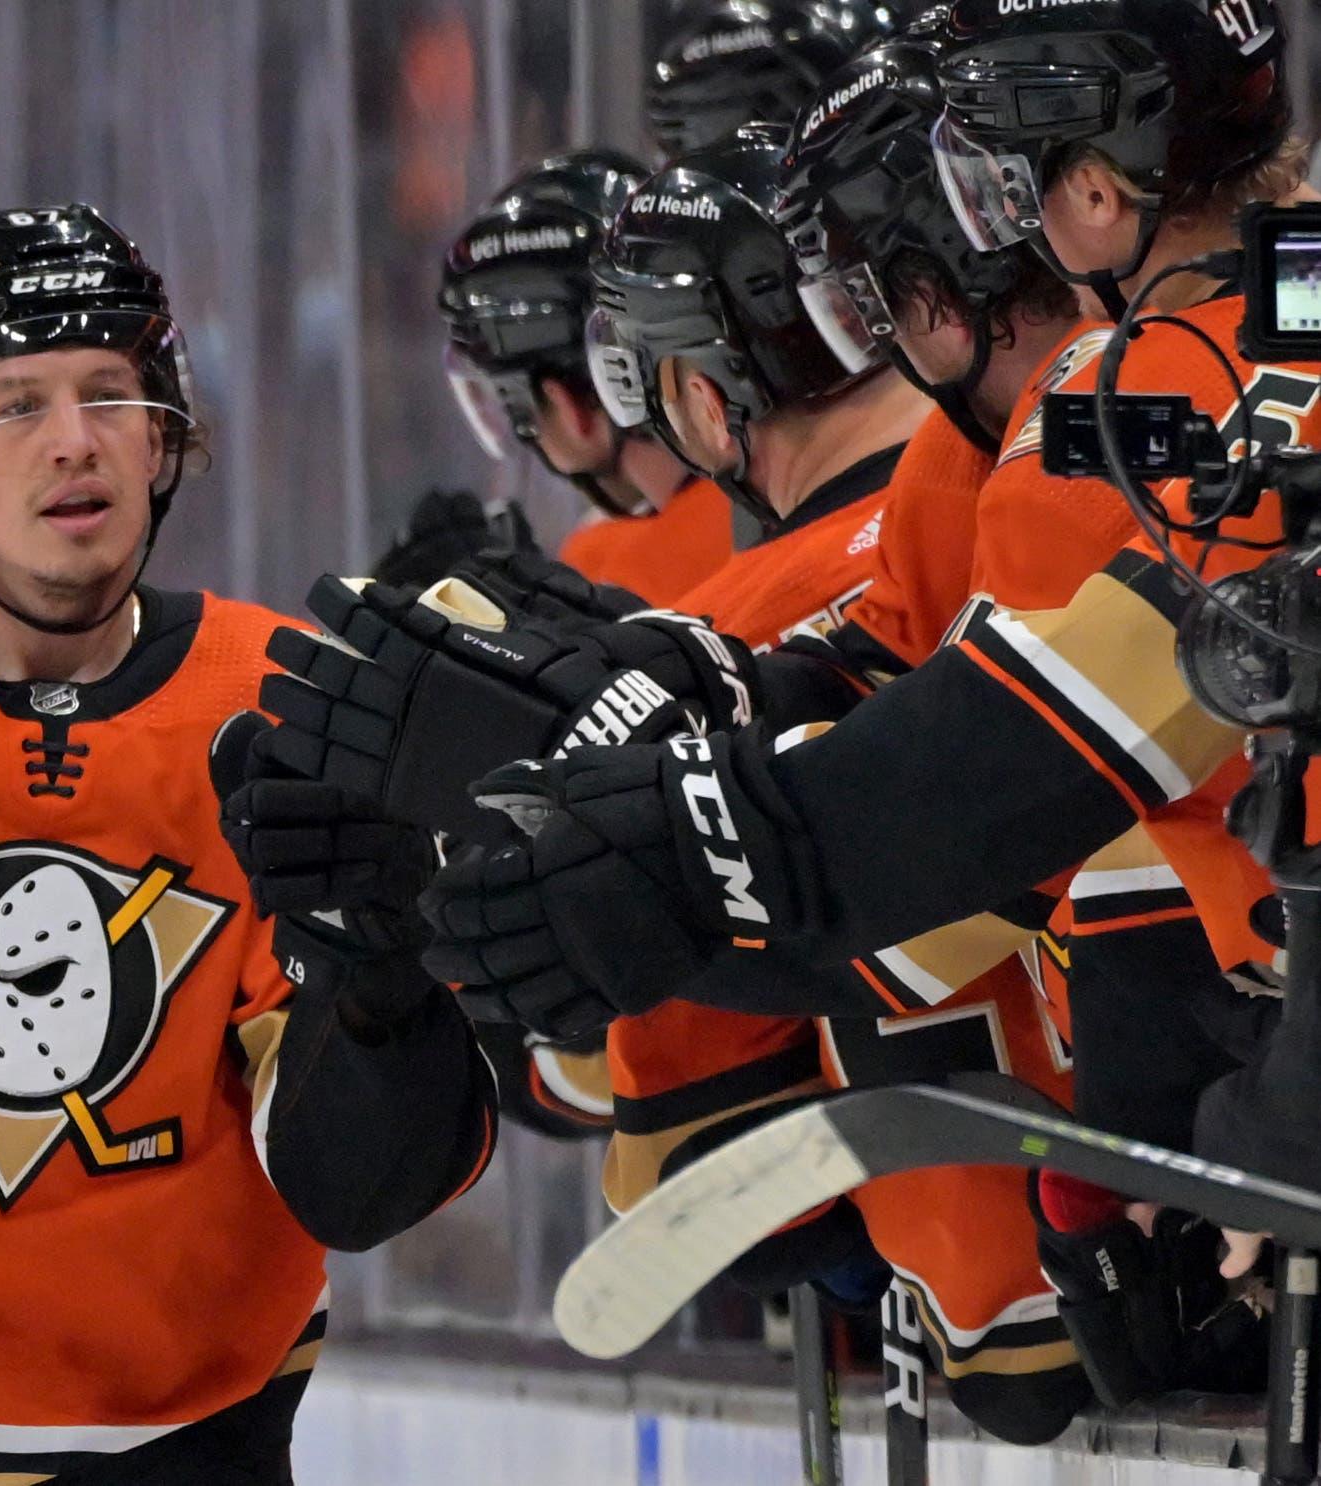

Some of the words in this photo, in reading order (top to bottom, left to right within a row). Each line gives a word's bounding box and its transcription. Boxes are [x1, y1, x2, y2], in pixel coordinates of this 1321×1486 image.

[1214, 0, 1259, 42] 47
[711, 26, 775, 54] Health
[827, 67, 884, 115] Health
[8, 210, 59, 227] 67
[631, 193, 657, 214] UCI
[658, 194, 721, 221] Health
[470, 233, 501, 262] UCI
[503, 225, 572, 254] Health
[9, 270, 106, 295] CCM
[463, 632, 525, 662] ALPHA
[668, 732, 771, 925] CCM
